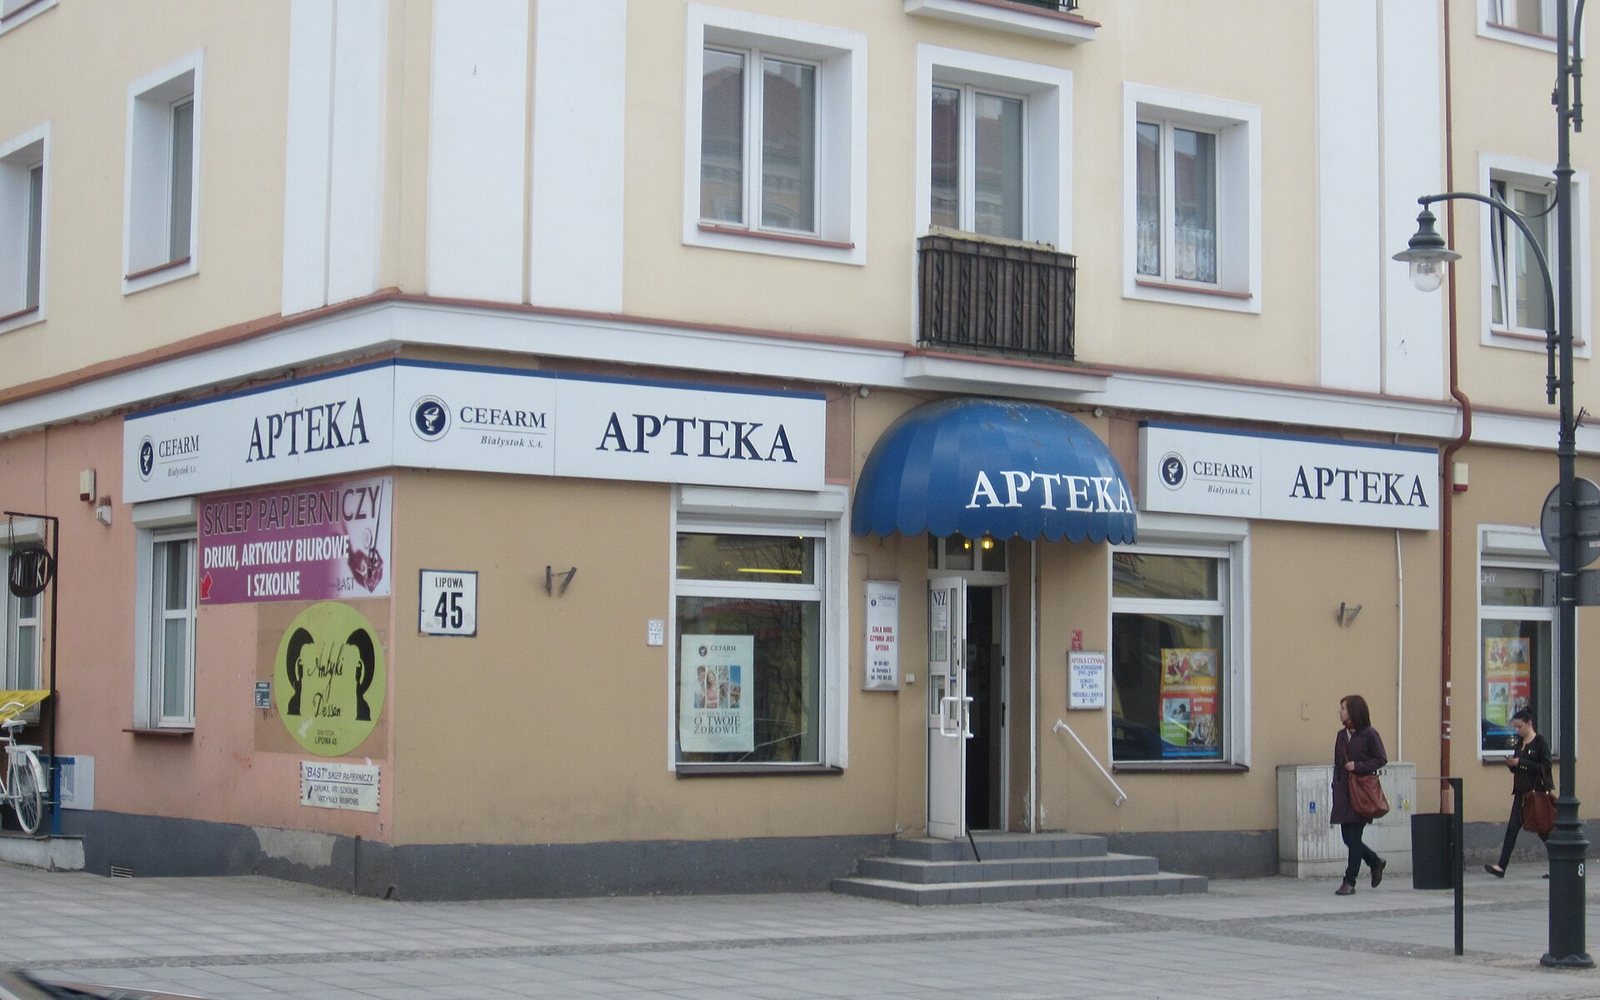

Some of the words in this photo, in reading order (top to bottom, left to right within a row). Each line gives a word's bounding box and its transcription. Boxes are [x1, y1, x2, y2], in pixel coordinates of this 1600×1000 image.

[246, 397, 369, 463] APTEKA
[460, 406, 546, 428] CEFARM
[158, 434, 199, 458] CEFARM
[595, 411, 798, 463] APTEKA
[1193, 460, 1254, 479] CEFARM
[965, 470, 1132, 513] APTEKA
[1289, 464, 1429, 508] APTEKA
[204, 500, 253, 537] SKLEP
[257, 485, 381, 531] PAPIERNICZY
[204, 544, 240, 571] DRUKI,
[241, 539, 294, 567] ARTYKUŁY
[295, 534, 350, 562] BIUROWE
[247, 574, 251, 597] I
[253, 571, 300, 597] SZKOLNE
[435, 576, 463, 588] LIPOWA
[434, 591, 463, 629] 45
[693, 726, 740, 735] ZDROWIE
[1577, 863, 1584, 877] 8
